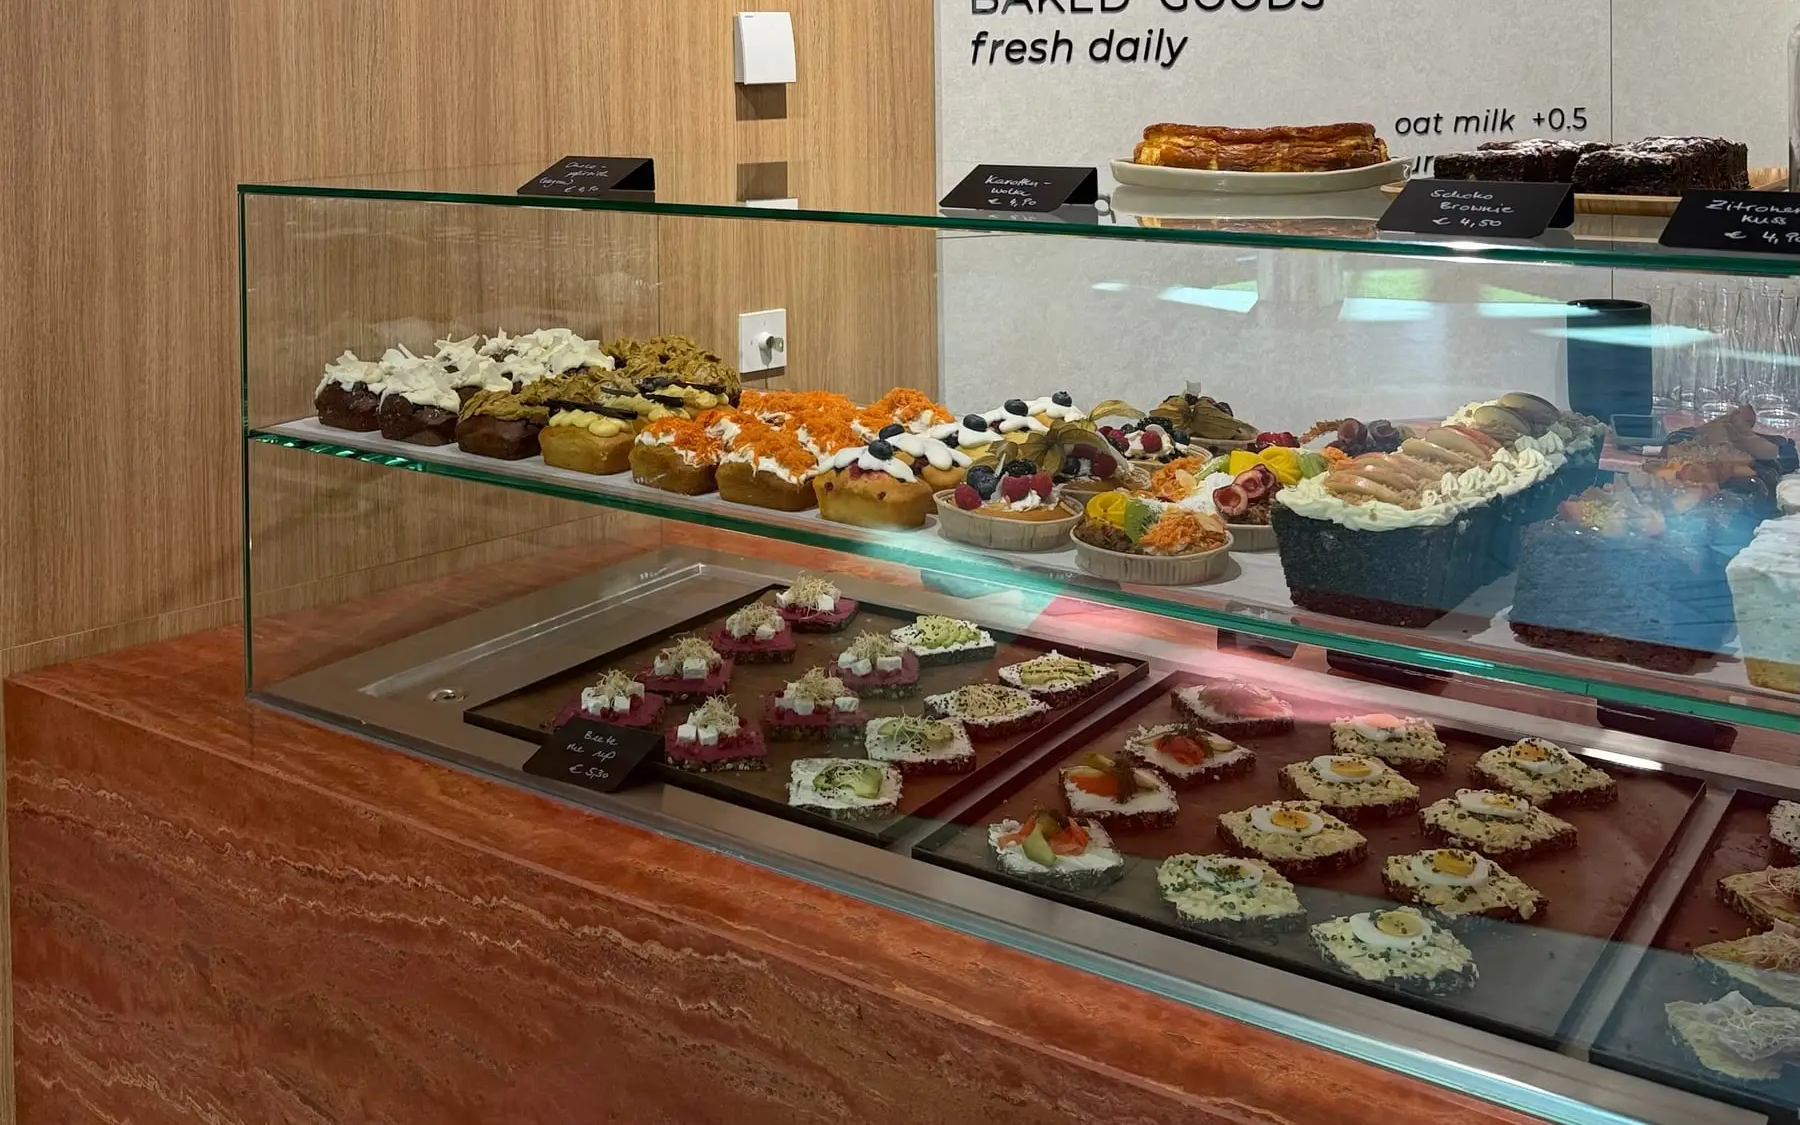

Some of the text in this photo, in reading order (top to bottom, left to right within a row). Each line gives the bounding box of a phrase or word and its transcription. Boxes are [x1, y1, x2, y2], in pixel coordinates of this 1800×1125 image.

[970, 27, 1189, 71] fresh daily
[1394, 106, 1588, 137] oat milk +0.5
